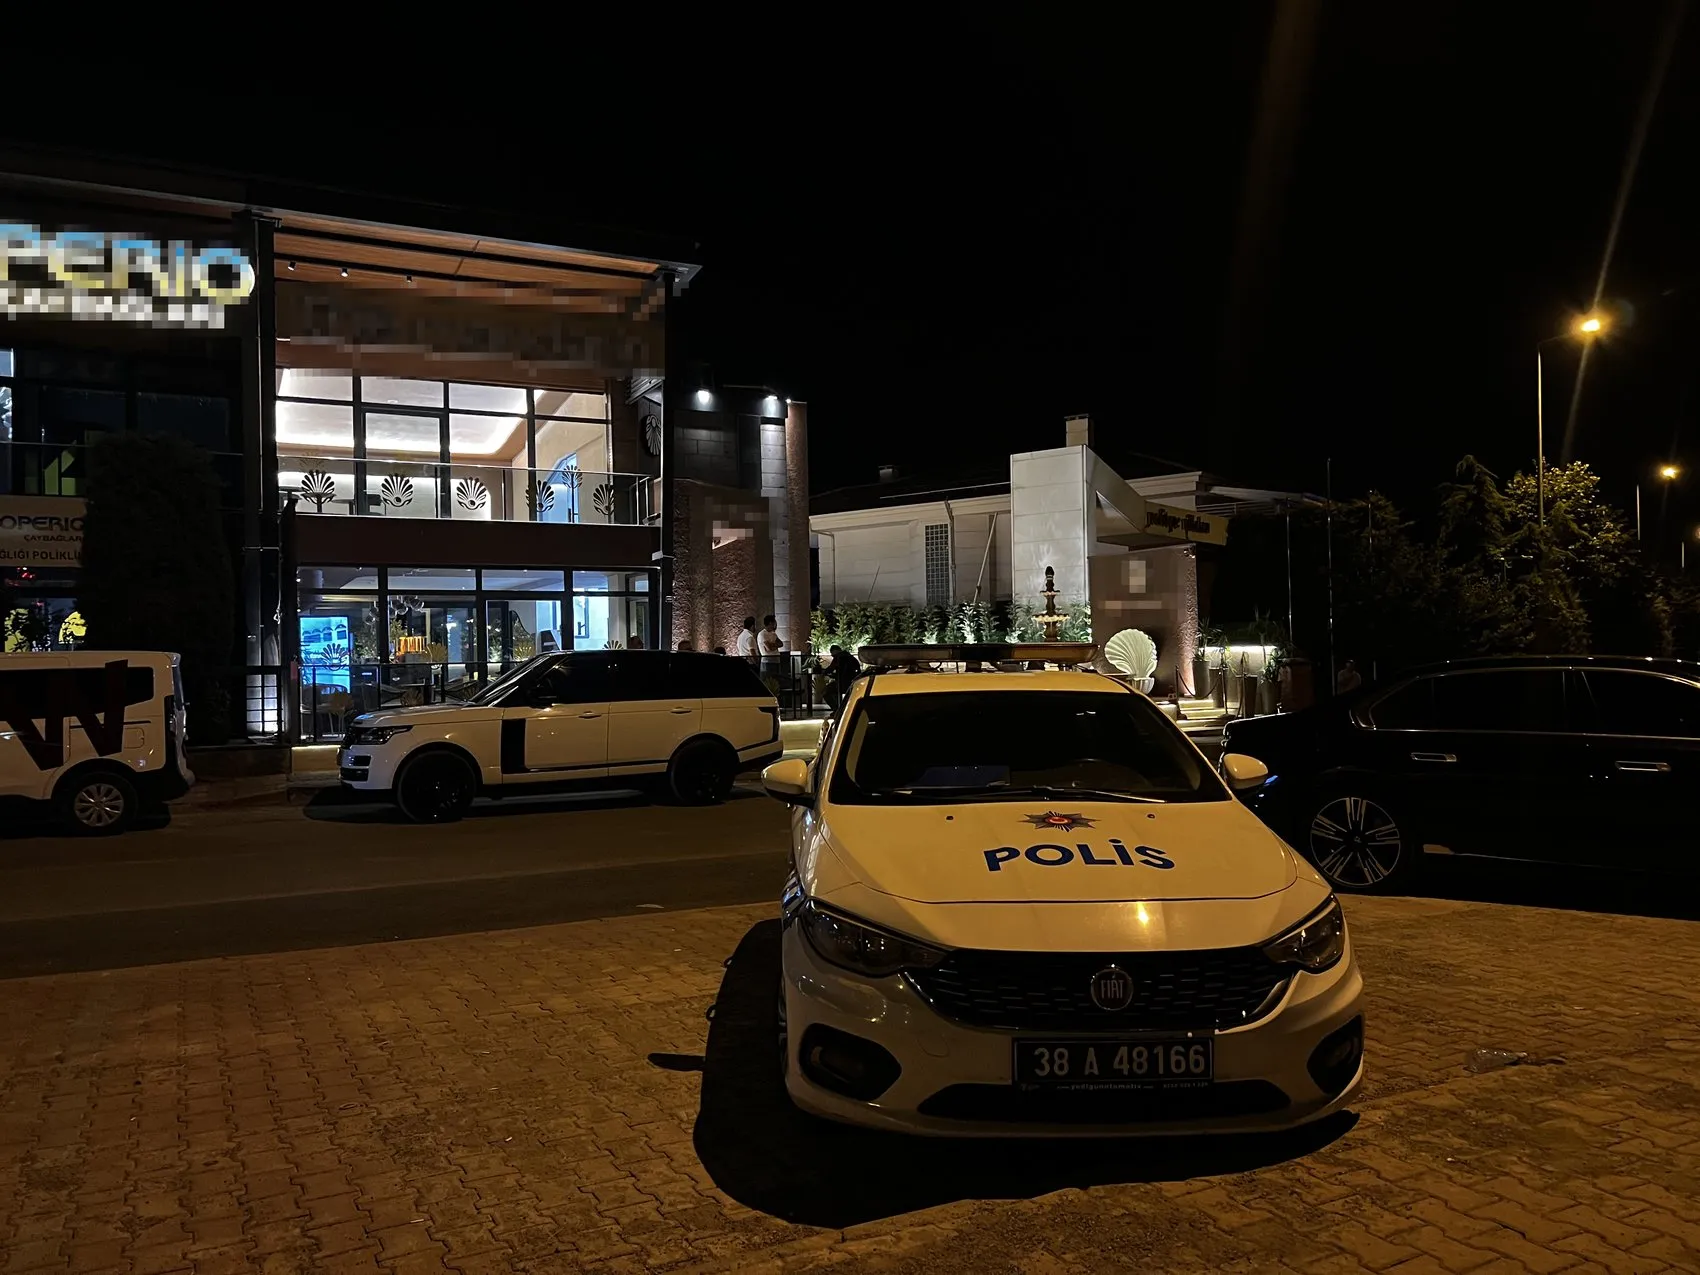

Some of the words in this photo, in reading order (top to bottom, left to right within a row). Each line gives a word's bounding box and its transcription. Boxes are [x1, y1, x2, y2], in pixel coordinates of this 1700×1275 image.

[983, 838, 1176, 872] POLİS
[1101, 979, 1125, 999] FIAT
[1034, 1047, 1070, 1077] 38
[1084, 1046, 1100, 1076] A
[1113, 1044, 1206, 1076] 48166
